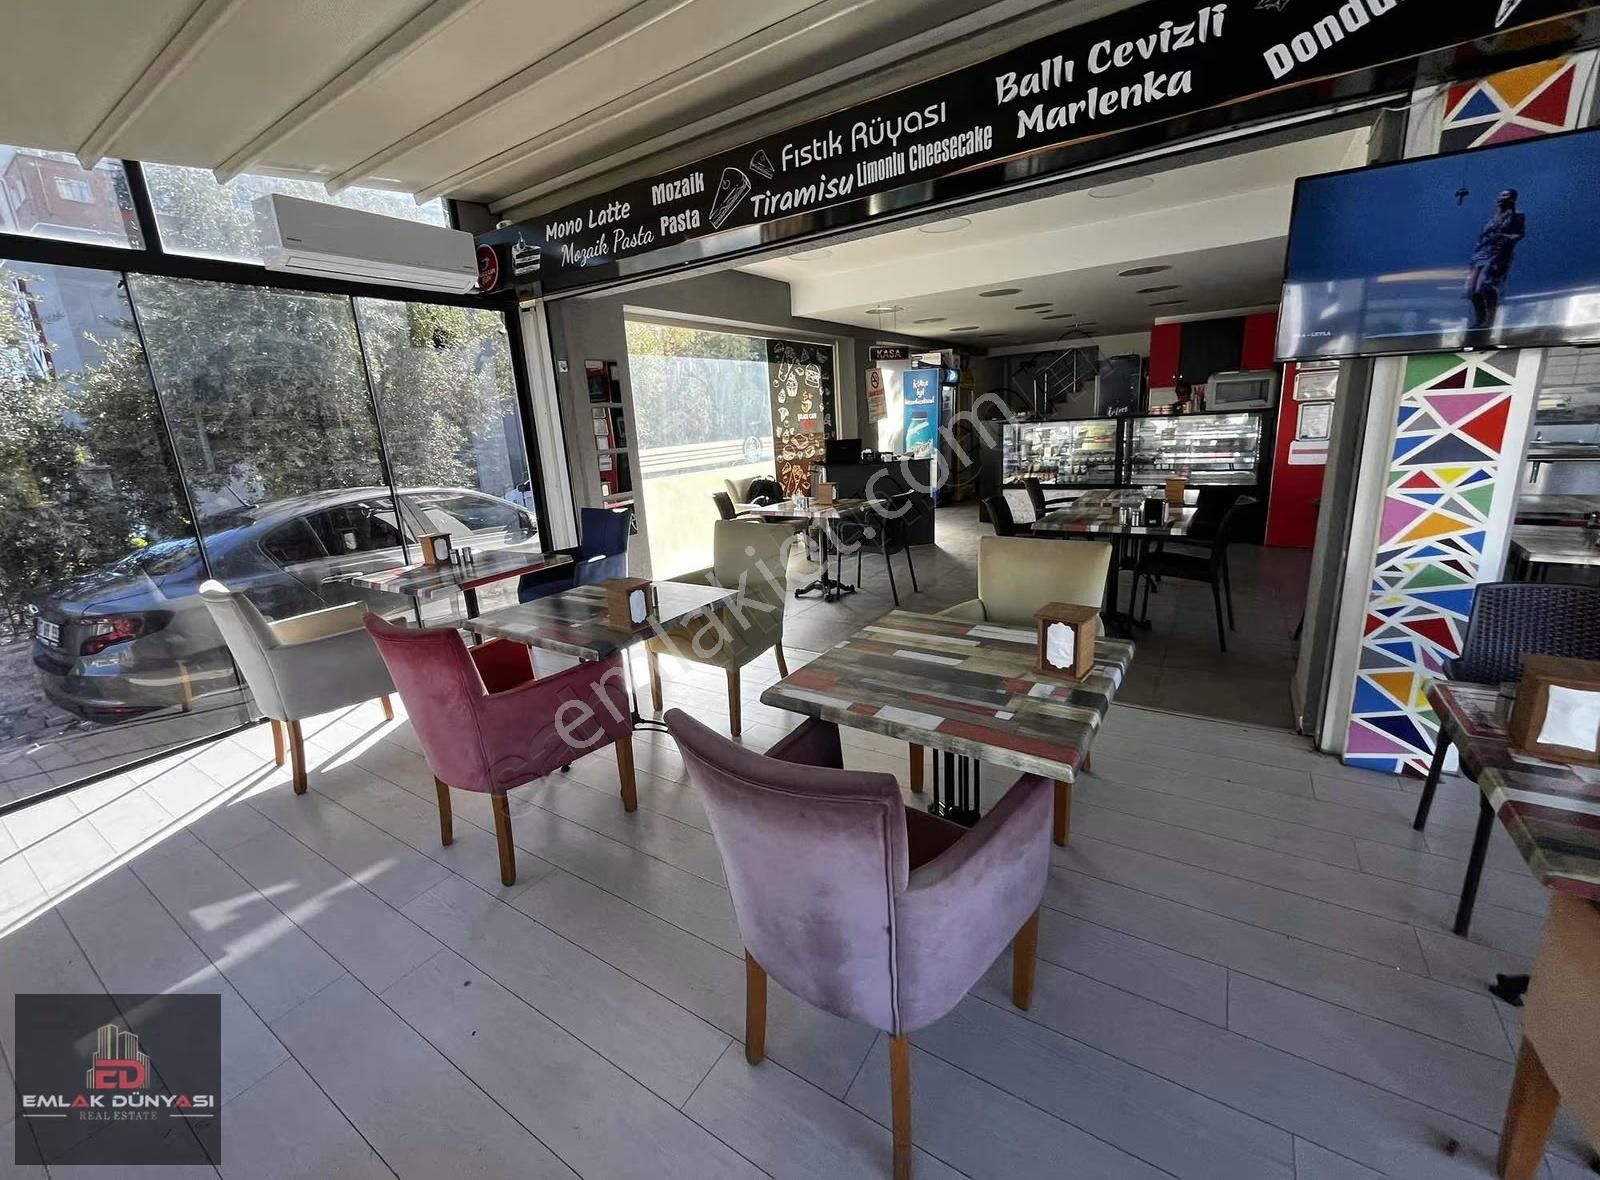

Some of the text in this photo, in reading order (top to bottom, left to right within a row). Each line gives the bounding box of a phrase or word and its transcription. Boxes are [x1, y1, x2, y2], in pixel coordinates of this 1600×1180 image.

[995, 3, 1228, 106] Ballı Cevizli
[1016, 69, 1193, 139] Marlenka
[851, 101, 947, 153] Rüyası
[856, 125, 993, 187] Limonlu Cheesecake
[651, 170, 706, 206] Mozaik
[750, 173, 855, 218] Tiramisu
[545, 200, 632, 243] Mono Latte
[660, 208, 701, 237] Pasta
[561, 225, 655, 267] Mozaik Pasta
[876, 348, 902, 359] KASA
